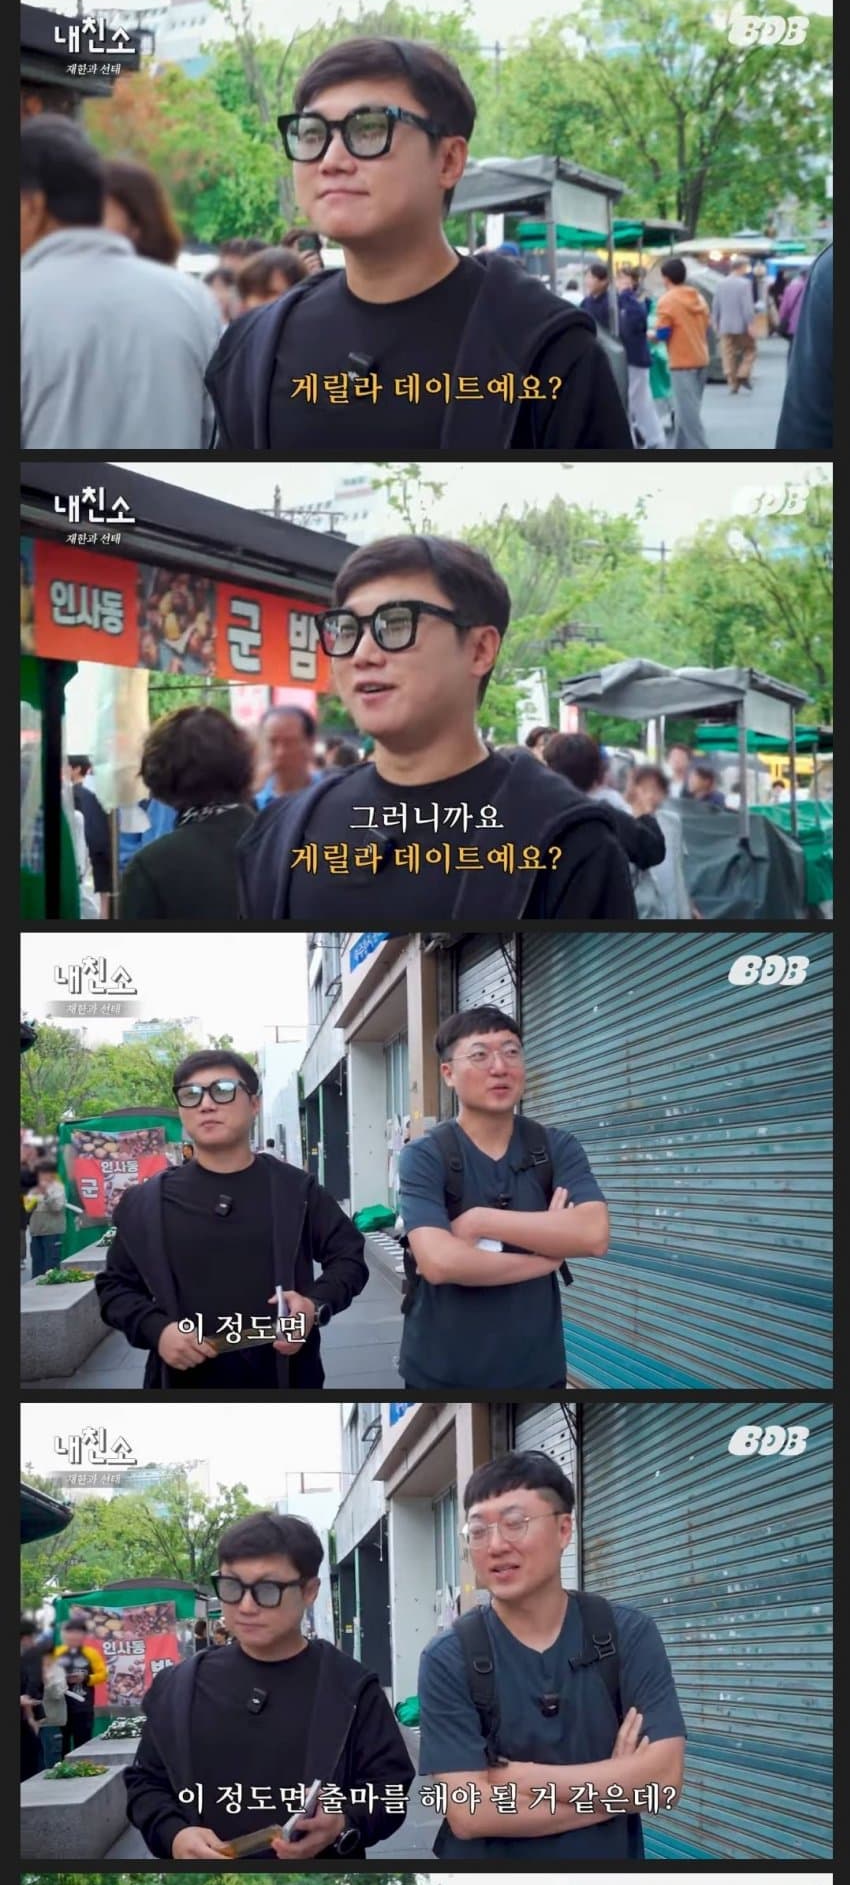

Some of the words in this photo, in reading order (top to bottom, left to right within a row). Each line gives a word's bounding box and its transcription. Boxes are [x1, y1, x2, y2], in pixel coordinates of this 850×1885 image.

[50, 579, 124, 635] 인사동
[227, 597, 262, 674] 군
[101, 1160, 138, 1173] 인사동
[80, 1178, 98, 1199] 군
[102, 1639, 146, 1656] 인사동
